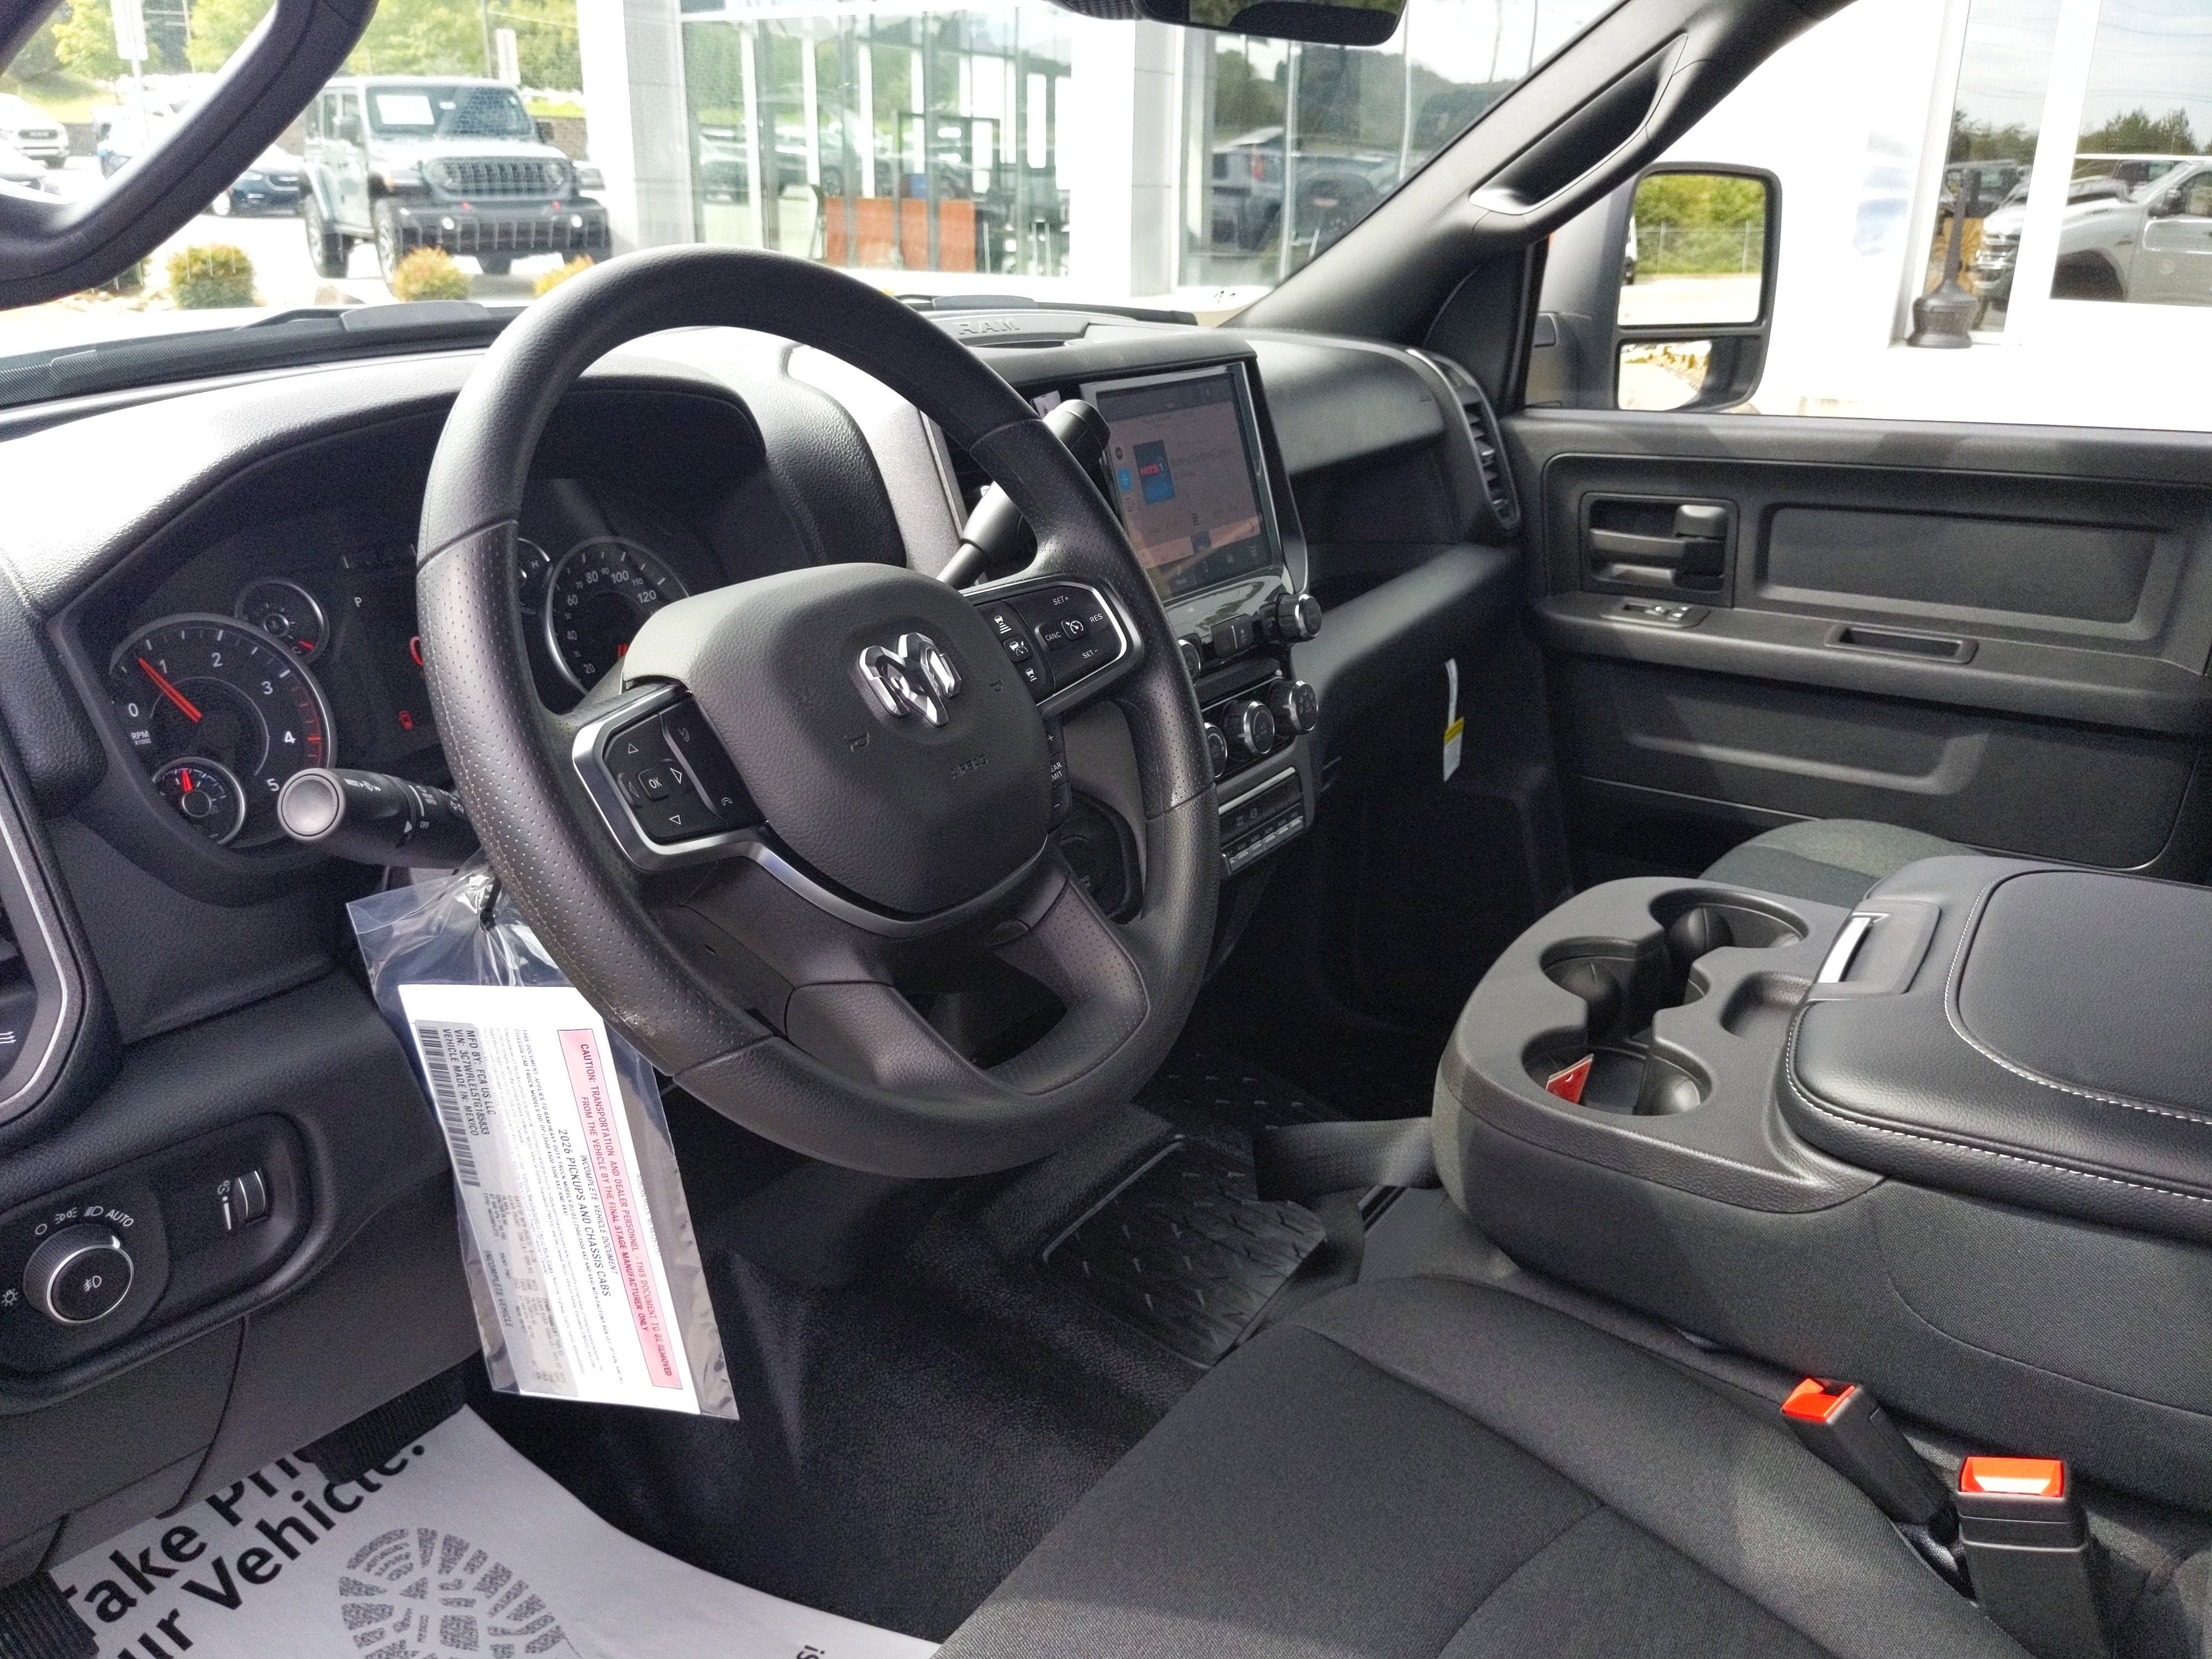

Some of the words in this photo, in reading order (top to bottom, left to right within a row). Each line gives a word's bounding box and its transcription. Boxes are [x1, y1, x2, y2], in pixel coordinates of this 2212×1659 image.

[953, 318, 1021, 336] RAM
[585, 570, 599, 584] 80
[611, 570, 630, 584] 100
[354, 596, 362, 607] P
[567, 594, 579, 606] 60
[637, 589, 657, 603] 120
[1090, 613, 1104, 624] RES
[1045, 631, 1062, 642] CANC
[160, 659, 168, 674] 1
[211, 651, 224, 668] 2
[583, 663, 596, 674] 20
[262, 680, 274, 696] 3
[127, 703, 139, 718] 0
[131, 730, 150, 740] RPM
[284, 730, 297, 746] 4
[1051, 761, 1063, 772] EAR
[648, 776, 663, 789] OK
[1051, 770, 1063, 782] MIT
[267, 778, 280, 792] 5
[443, 1029, 459, 1062] VEHICLE
[454, 1029, 465, 1046] VIN:
[466, 1030, 478, 1048] MFD
[471, 1051, 482, 1065] BY:
[580, 1044, 596, 1082] CAUTION:
[453, 1065, 466, 1088] MADE
[476, 1069, 488, 1084] FCA
[514, 1029, 524, 1053] CHASSIS
[525, 1069, 533, 1088] TRUCK
[531, 1090, 540, 1111] MODELS
[459, 1091, 469, 1102] IN:
[481, 1087, 491, 1098] US
[484, 1101, 496, 1115] LLC
[522, 1029, 530, 1042] THIS
[526, 1044, 538, 1074] DOCUMENT
[534, 1077, 545, 1101] APPLIES
[548, 1125, 556, 1143] HEAVY
[552, 1144, 561, 1159] DUTY
[557, 1161, 566, 1179] TRUCK
[563, 1181, 573, 1202] MODELS
[581, 1097, 593, 1118] FROM
[464, 1105, 479, 1136] MEXICO
[587, 1121, 597, 1136] THE
[591, 1086, 614, 1156] TRANSPORTATION
[558, 1129, 573, 1154] 2026
[592, 1139, 607, 1170] VEHICLE
[610, 1160, 620, 1176] AND
[566, 1157, 585, 1200] PICKUPS
[601, 1173, 610, 1182] BY
[604, 1185, 614, 1200] THE
[614, 1179, 628, 1207] DEALER
[105, 1209, 135, 1228] AUTO
[578, 1203, 591, 1224] AND
[580, 1154, 599, 1200] INCOMPLETE
[594, 1205, 607, 1233] VEHICLE
[601, 1236, 618, 1274] DOCUMENT
[608, 1201, 620, 1223] FINAL
[614, 1226, 627, 1249] STAGE
[622, 1210, 639, 1251] PERSONNEL
[584, 1227, 603, 1268] CHASSIS
[636, 1261, 646, 1277] THIS
[485, 1250, 503, 1295] INCOMPLETE
[498, 1299, 513, 1327] VEHICLE
[596, 1271, 611, 1296] CABS
[622, 1252, 643, 1310] MANUFACTURER
[640, 1280, 657, 1318] DOCUMENT
[637, 1313, 648, 1331] ONLY
[651, 1322, 660, 1331] TO
[654, 1333, 663, 1342] BE
[657, 1344, 672, 1376] REMOVED
[60, 1526, 207, 1622] ake
